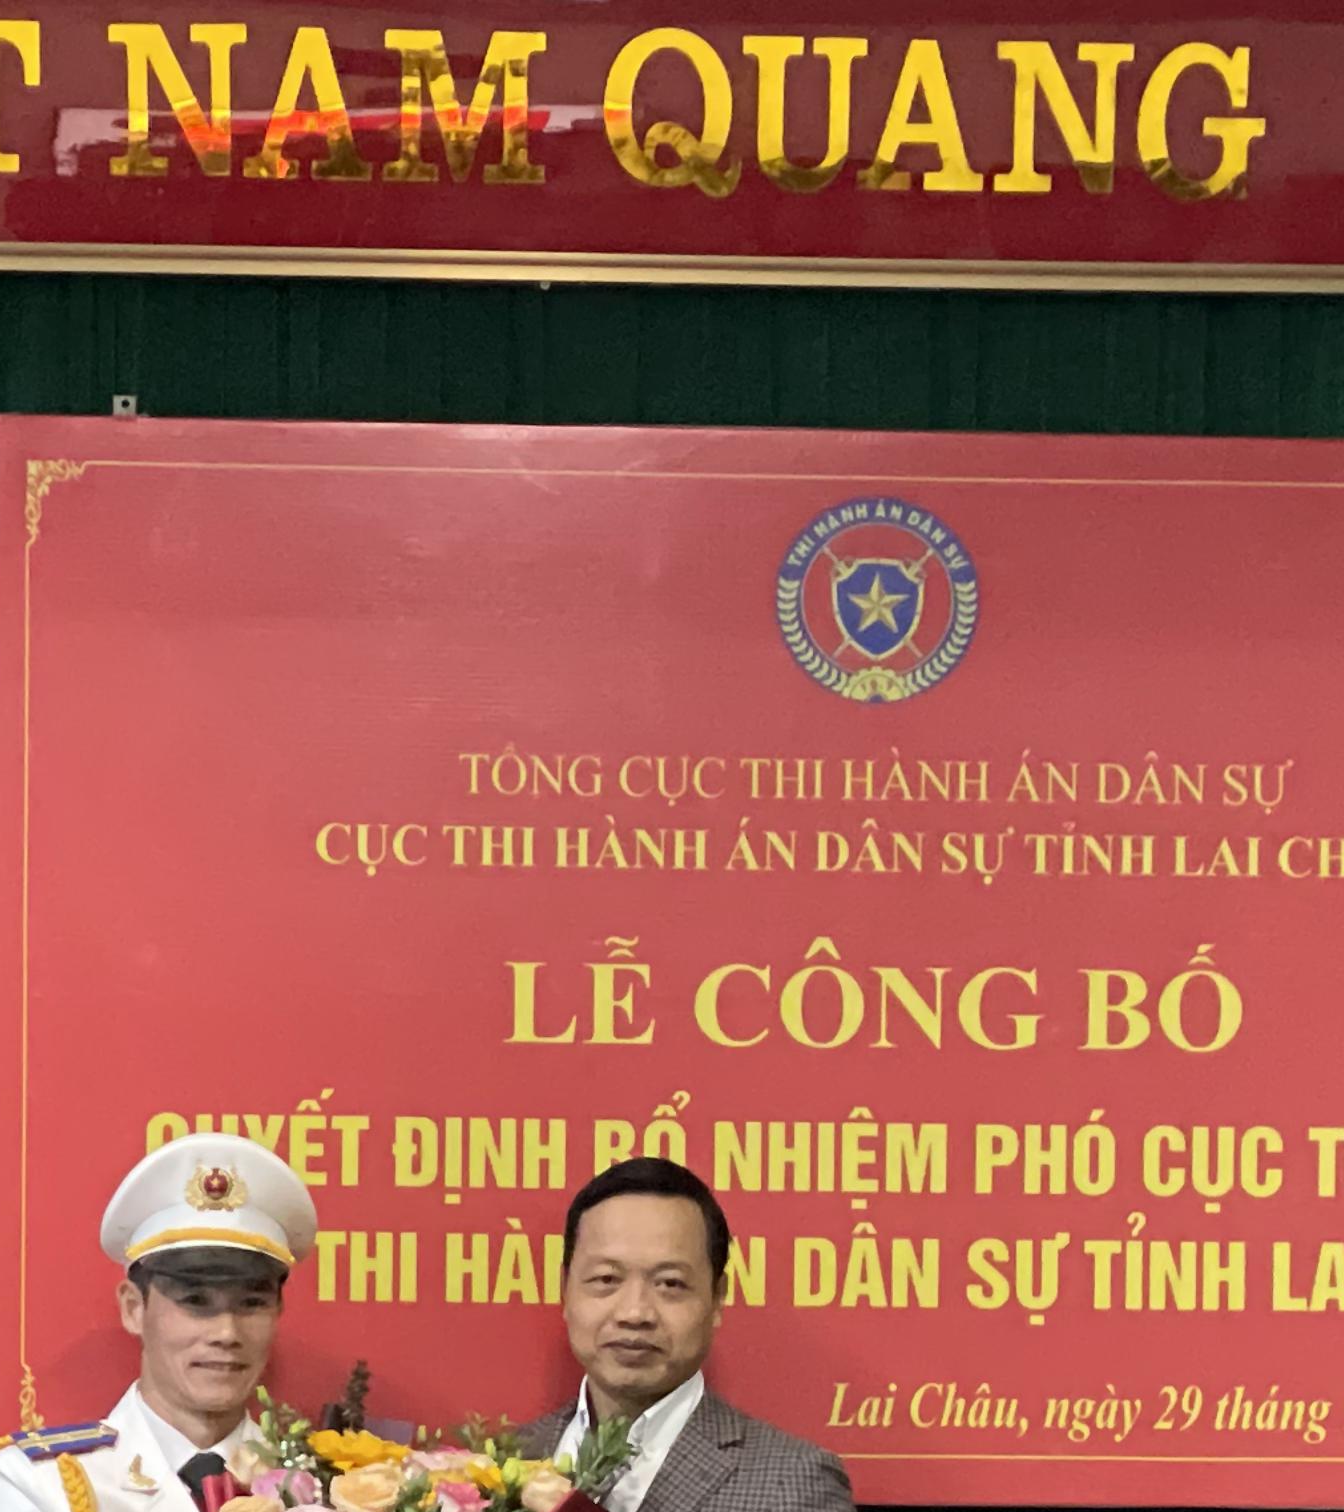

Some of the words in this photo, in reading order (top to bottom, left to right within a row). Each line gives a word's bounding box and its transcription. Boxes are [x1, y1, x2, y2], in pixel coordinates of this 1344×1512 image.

[106, 22, 548, 184] NAM
[602, 26, 1267, 199] QUANG
[787, 534, 815, 567] THI
[619, 756, 724, 806] CỤC
[741, 758, 823, 799] THI
[843, 747, 988, 801] HÀNH
[1008, 750, 1078, 803] ÁN
[1098, 751, 1205, 804] DÂN
[1223, 760, 1293, 814] SỰ
[316, 823, 427, 876] CỤC
[443, 825, 534, 866] THI
[556, 815, 706, 869] HÀNH
[726, 817, 795, 870] ÁN
[816, 818, 923, 872] DÂN
[942, 827, 1014, 885] SỰ
[1025, 824, 1154, 875] TỈNH
[1175, 836, 1260, 877] LAI
[505, 936, 655, 1044] LỄ
[694, 937, 1042, 1050] CÔNG
[1080, 944, 1242, 1052] BỐ
[392, 1116, 566, 1204] ĐỊNH
[714, 1107, 947, 1209] NHIỆM
[975, 1109, 1115, 1196] PHÓ
[1142, 1125, 1284, 1214] CỤC
[315, 1231, 417, 1302] THI
[444, 1218, 564, 1304] HÀ
[794, 1222, 939, 1308] DÂN
[967, 1232, 1070, 1325] SỰ
[1084, 1211, 1246, 1312] TỈNH
[827, 1383, 897, 1427] Lai
[910, 1383, 1028, 1436] Châu,
[1044, 1384, 1141, 1442] ngày
[1154, 1386, 1202, 1430] 29
[1215, 1385, 1331, 1443] tháng
